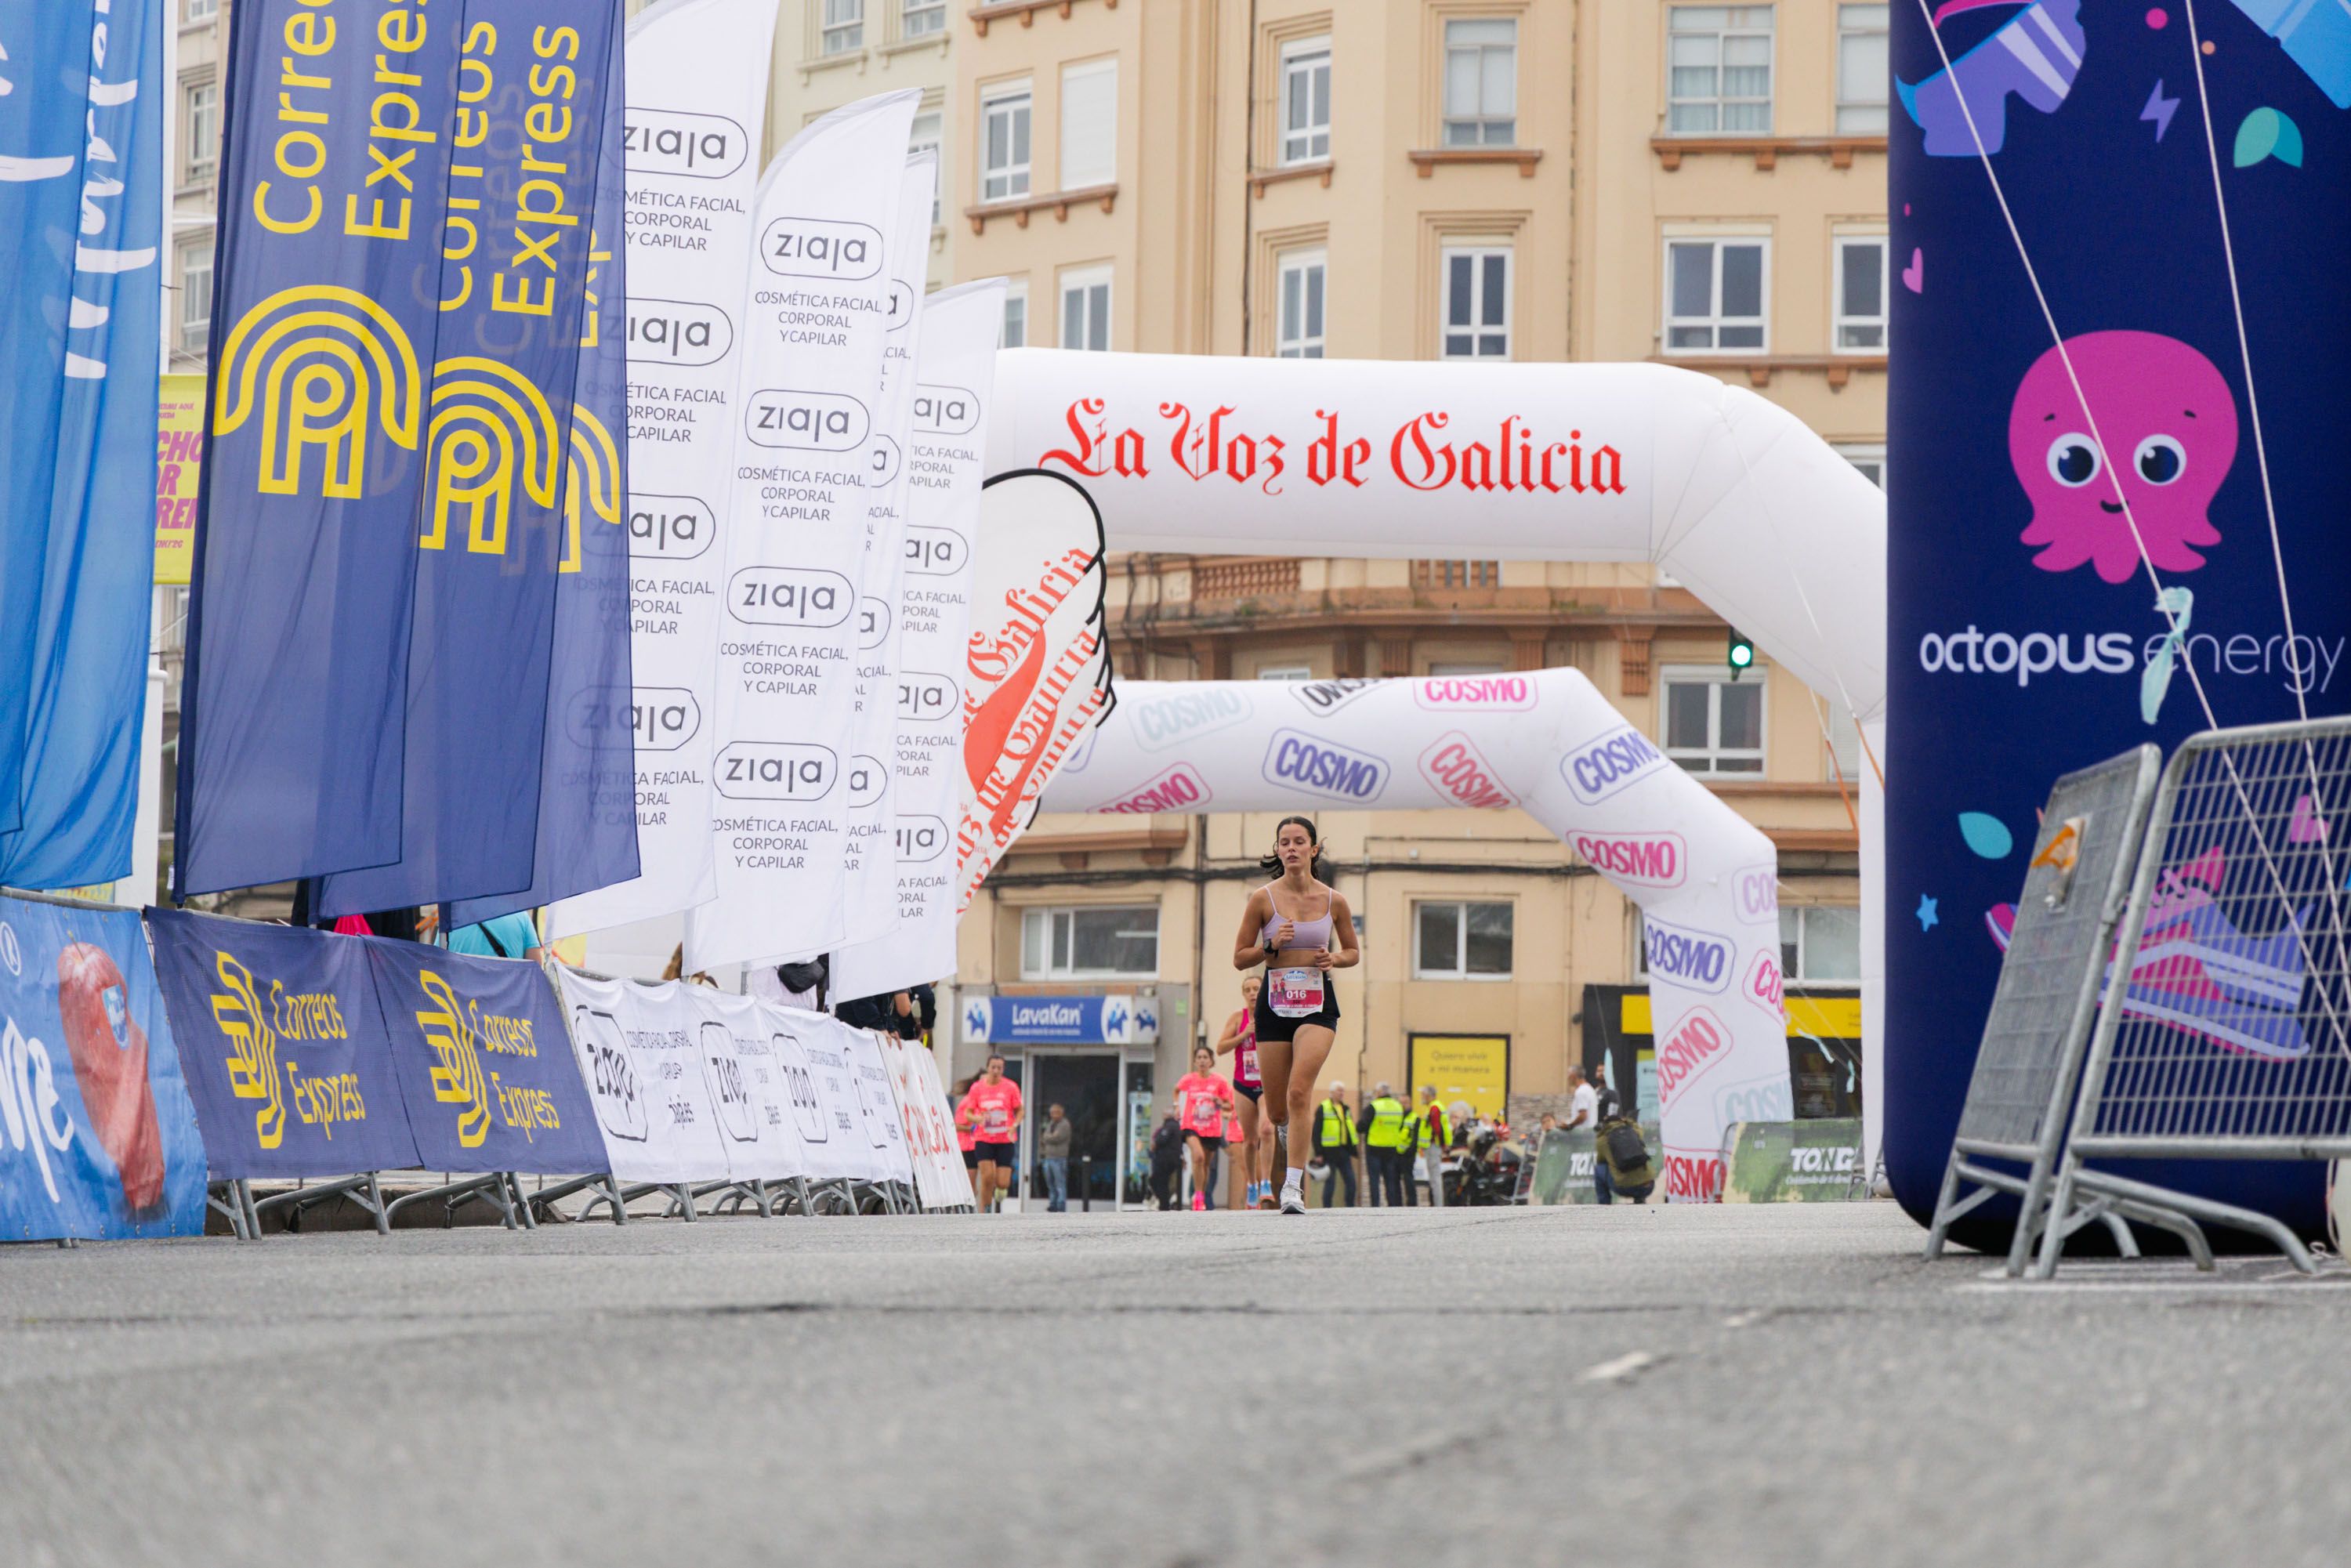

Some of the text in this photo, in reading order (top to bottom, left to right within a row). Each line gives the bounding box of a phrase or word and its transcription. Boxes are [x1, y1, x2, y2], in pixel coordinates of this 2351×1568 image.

[253, 0, 337, 234] Corre
[344, 0, 437, 241] Expre
[491, 25, 580, 317] Express
[690, 197, 746, 215] FACIAL,
[624, 211, 712, 232] CORPORAL
[639, 233, 708, 251] CAPILAR
[774, 234, 867, 272] ziaja
[755, 291, 830, 308] COSMÉTICA
[833, 297, 882, 313] FACIAL,
[778, 311, 852, 328] CORPORAL
[883, 346, 911, 360] CIAL,
[626, 425, 692, 443] CAPILAR
[757, 406, 849, 443] ziaja
[938, 448, 979, 462] FACIAL,
[1038, 398, 1628, 496] La Voz de Galicia
[737, 466, 865, 488] COSMÉTICA FACIAL,
[761, 487, 835, 503] CORPORAL
[662, 581, 715, 596] FACIAL,
[743, 583, 835, 619] ziaja
[721, 641, 849, 661] COSMÉTICA FACIAL,
[1919, 625, 2346, 694] octopus energy
[743, 662, 822, 678] CORPORAL
[744, 680, 817, 696] Y CAPILAR
[1424, 678, 1528, 704] COSMO
[1139, 686, 1241, 742] COSMO
[654, 770, 705, 786] FACIAL,
[726, 759, 822, 793] ziaja
[1275, 738, 1379, 798] COSMO
[790, 820, 839, 833] FACIAL,
[847, 823, 887, 838] ACIAL,
[733, 837, 809, 851] CORPORAL
[734, 856, 805, 869] Y CAPILAR
[1577, 836, 1675, 881] COSMO
[1286, 990, 1306, 999] 016
[269, 979, 348, 1041] Correos
[1012, 1003, 1081, 1027] LavaKan
[285, 1062, 367, 1142] Express
